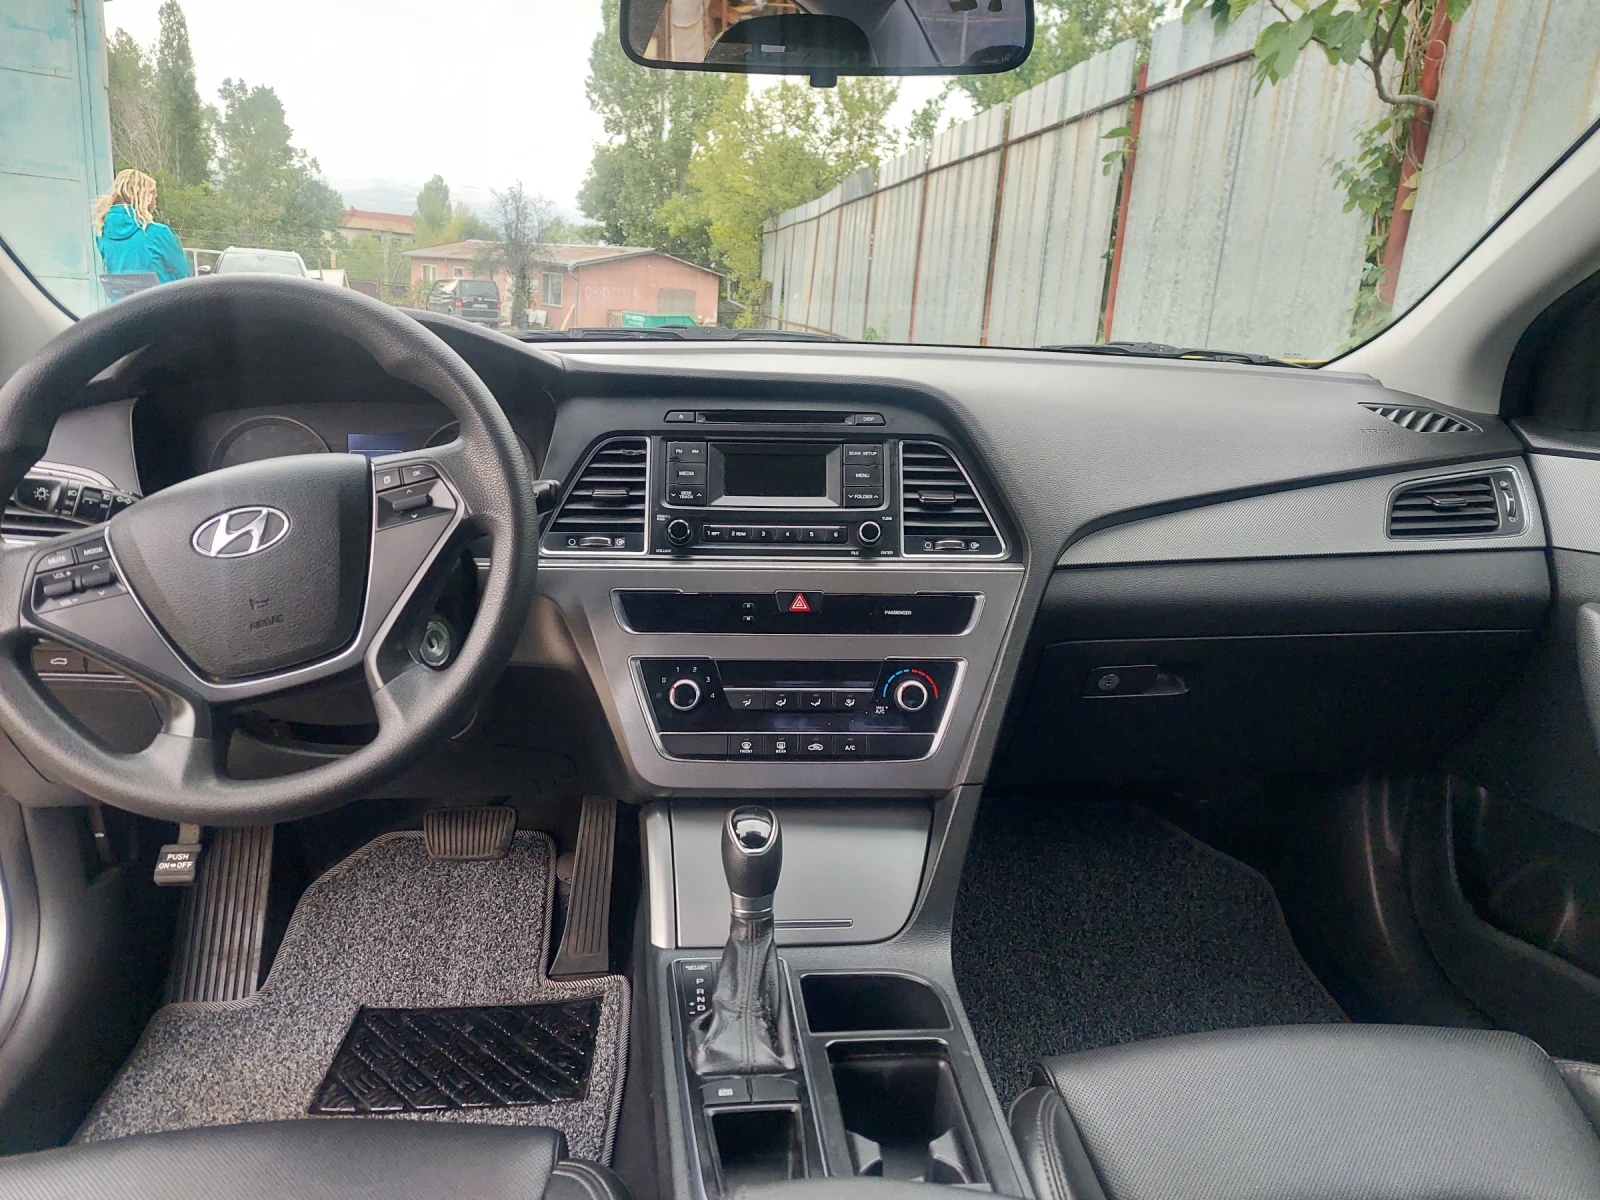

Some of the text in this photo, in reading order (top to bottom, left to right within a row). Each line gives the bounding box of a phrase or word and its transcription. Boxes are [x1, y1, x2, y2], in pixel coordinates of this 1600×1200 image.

[83, 546, 104, 556] MODE
[47, 555, 67, 565] MUTE
[166, 853, 189, 861] PUSH
[158, 861, 193, 870] ON OFF
[697, 1004, 706, 1012] D
